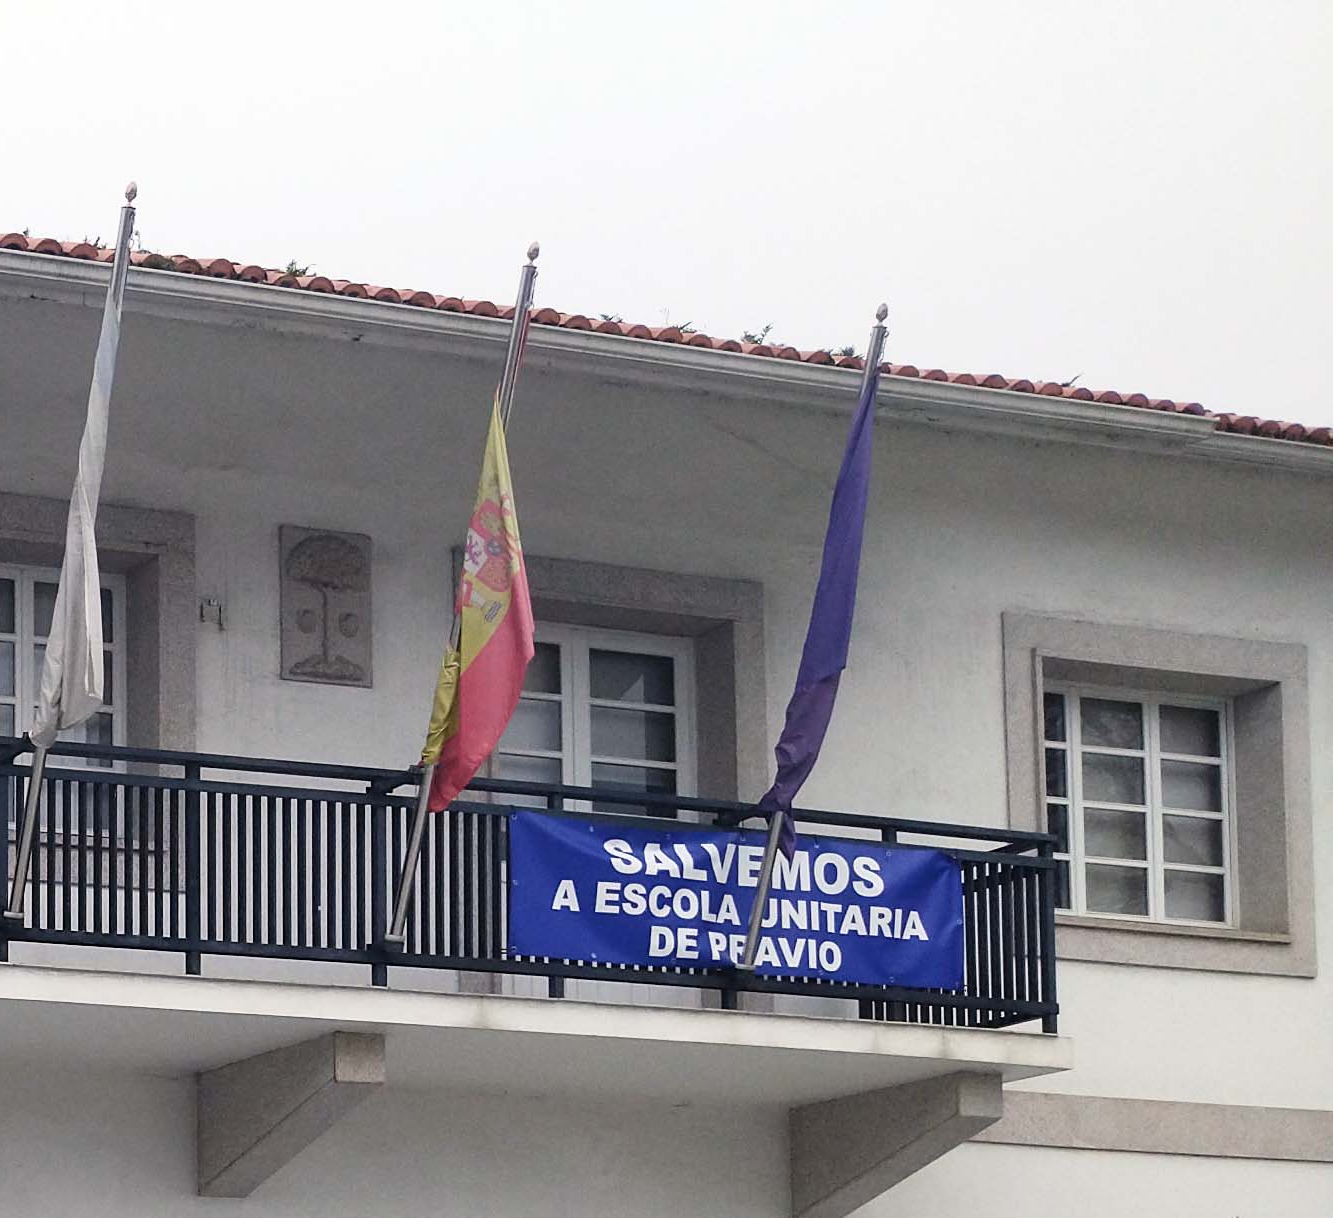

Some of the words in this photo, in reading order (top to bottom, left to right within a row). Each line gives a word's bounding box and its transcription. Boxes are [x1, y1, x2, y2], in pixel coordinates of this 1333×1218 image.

[603, 838, 885, 898] SALVEMOS
[551, 879, 580, 912] A
[594, 882, 741, 926] ESCOLA
[648, 925, 699, 960] DE
